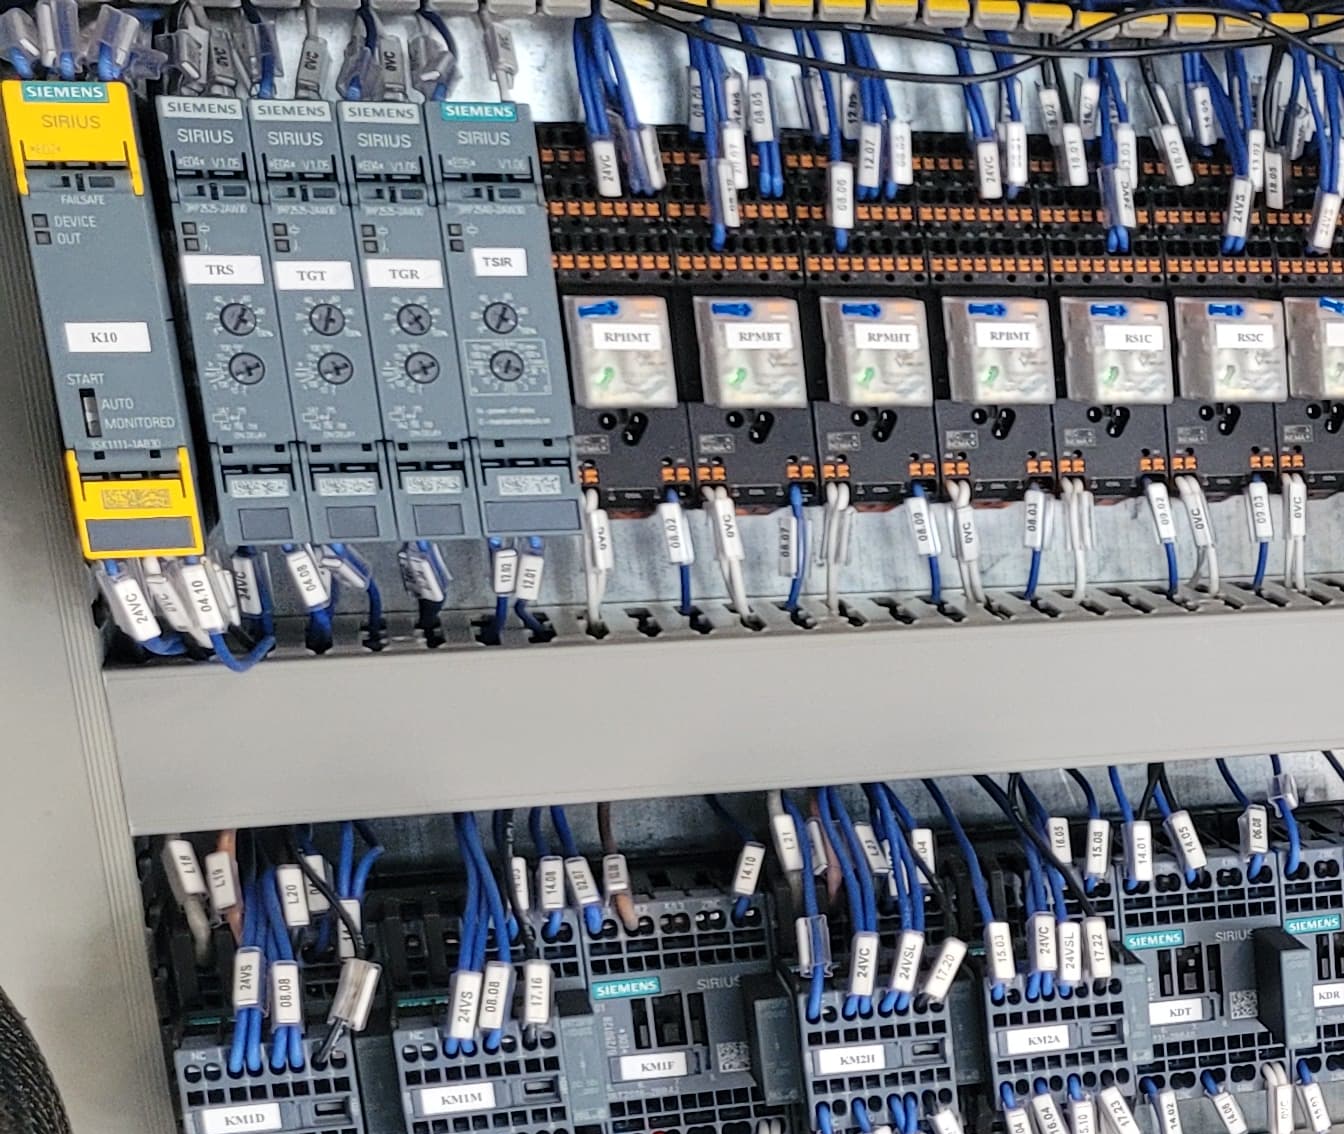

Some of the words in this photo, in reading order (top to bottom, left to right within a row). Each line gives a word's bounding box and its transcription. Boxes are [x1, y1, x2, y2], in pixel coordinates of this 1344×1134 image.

[26, 86, 104, 98] SIEMENS
[167, 102, 237, 115] SIEMENS
[257, 105, 325, 117] SIEMENS
[349, 107, 414, 119] SIEMENS
[446, 106, 513, 117] SIEMENS
[41, 114, 101, 129] SIRIUS
[177, 129, 234, 144] SIRIUS
[267, 131, 323, 146] SIRIUS
[358, 134, 412, 148] SIRIUS
[457, 132, 510, 146] SIRIUS
[600, 154, 613, 181] 24VC
[984, 155, 996, 183] 24VC
[54, 215, 97, 228] DEVICE
[57, 233, 81, 245] OUT
[482, 257, 512, 267] TSIR
[296, 270, 327, 281] TGT
[389, 268, 420, 280] TGR
[91, 331, 117, 343] K10
[1125, 334, 1152, 344] RS1C
[1238, 332, 1264, 343] RS2C
[67, 374, 103, 385] START
[102, 398, 133, 409] AUTO
[105, 417, 175, 429] MONITORED
[1191, 507, 1204, 530] 0VC
[723, 514, 734, 538] 0VC
[963, 521, 973, 543] 0VC
[665, 518, 681, 549] 08.02
[193, 581, 211, 612] 04.10
[1178, 826, 1196, 853] 14.05
[740, 856, 757, 881] 14.10
[216, 868, 225, 888] L19
[287, 885, 299, 905] L20
[1289, 918, 1339, 931] SIEMENS
[1039, 926, 1050, 954] 24VC
[1129, 934, 1181, 946] SIEMENS
[1215, 929, 1254, 942] SIRIUS
[1092, 934, 1104, 961] 17.22
[857, 947, 870, 978] 24VC
[899, 944, 916, 979] 24VSL
[240, 964, 253, 990] 24VS
[697, 976, 742, 990] SIRIUS
[278, 978, 291, 1008] 08.08
[597, 981, 657, 997] SIEMENS
[1319, 990, 1339, 1001] KDR
[485, 981, 501, 1013] 08.08
[458, 990, 473, 1023] 24VS
[1028, 1034, 1060, 1046] KM2A
[191, 1052, 206, 1061] NC
[224, 1113, 265, 1126] KM1D
[1044, 1107, 1060, 1134] 16.04
[1111, 1101, 1130, 1127] 17.23
